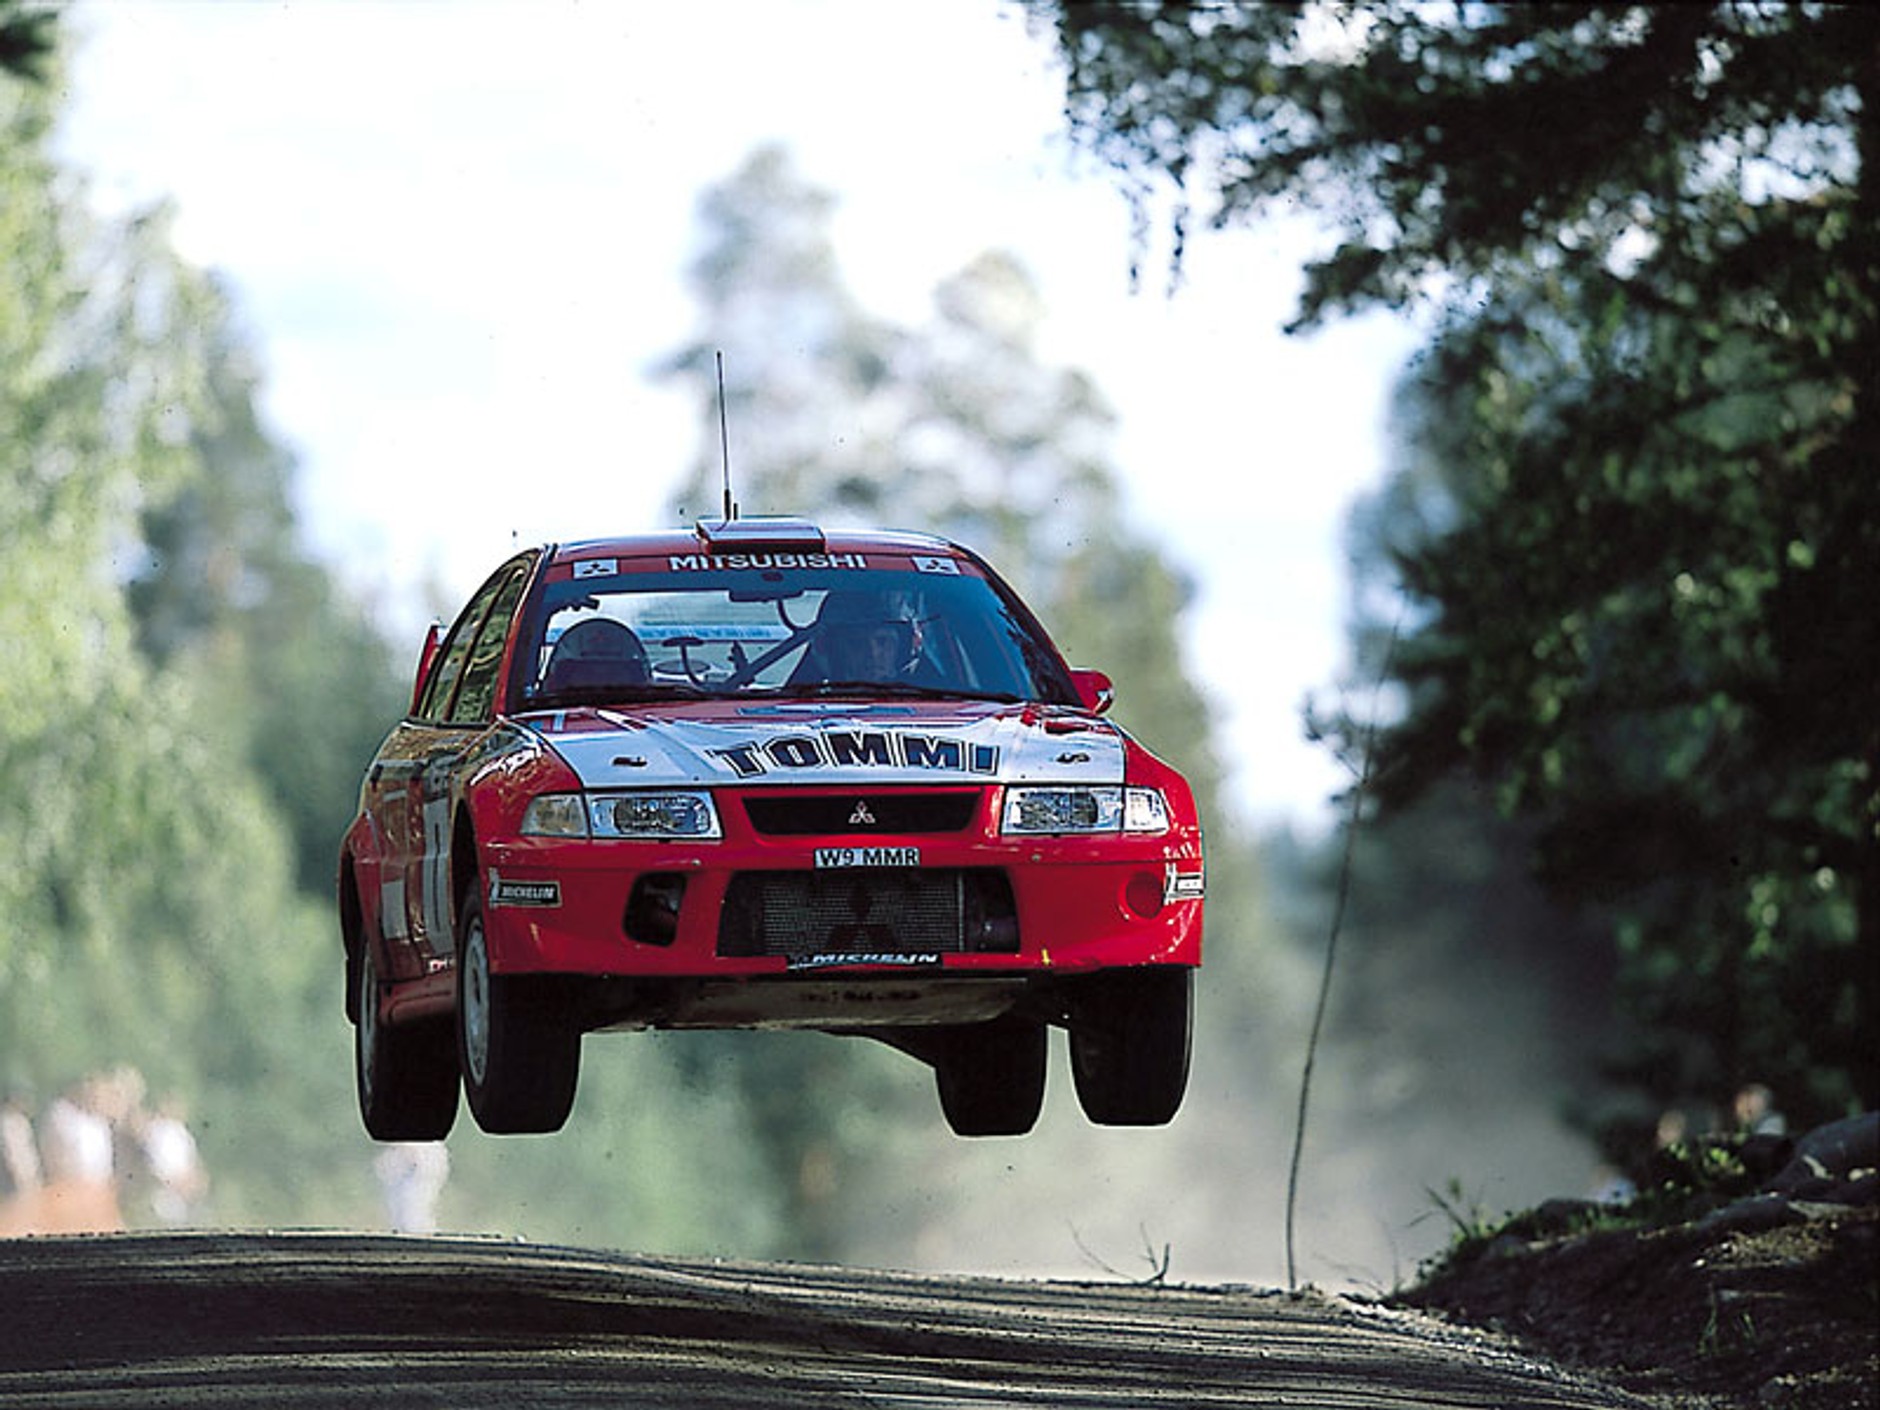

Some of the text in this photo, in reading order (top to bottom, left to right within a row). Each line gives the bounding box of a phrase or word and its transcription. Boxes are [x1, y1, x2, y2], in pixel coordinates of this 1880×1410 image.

[669, 554, 867, 570] MITSUBISHI
[705, 730, 999, 778] TOMMI
[820, 848, 917, 866] W9 MMR
